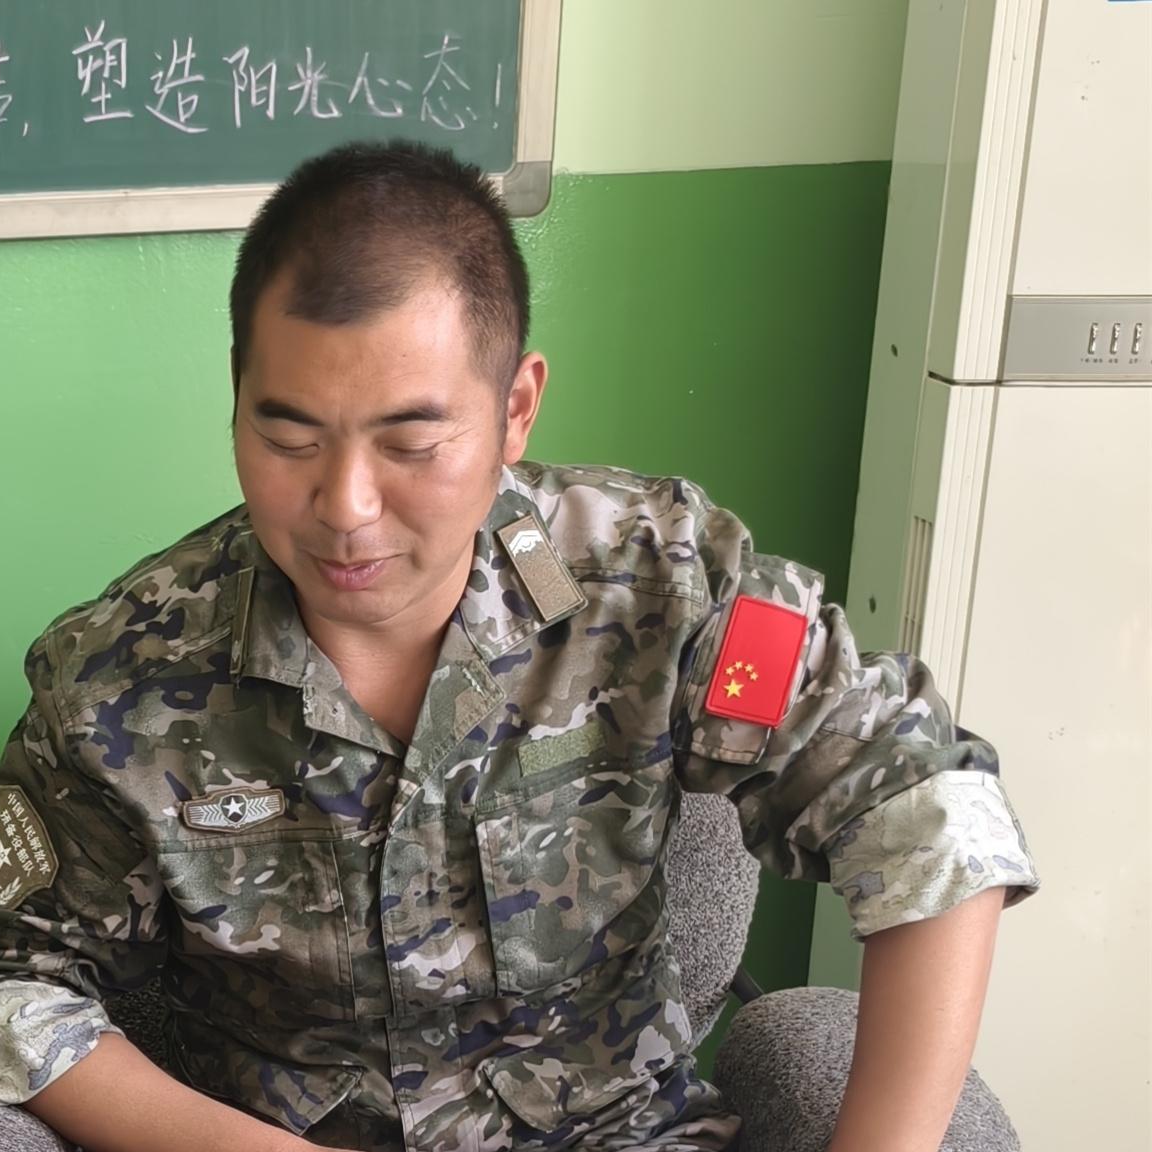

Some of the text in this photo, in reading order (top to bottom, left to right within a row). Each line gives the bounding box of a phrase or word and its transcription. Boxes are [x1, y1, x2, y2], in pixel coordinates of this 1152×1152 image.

[0, 808, 35, 878] 预备役部队
[7, 792, 51, 876] 中国人民解放军
